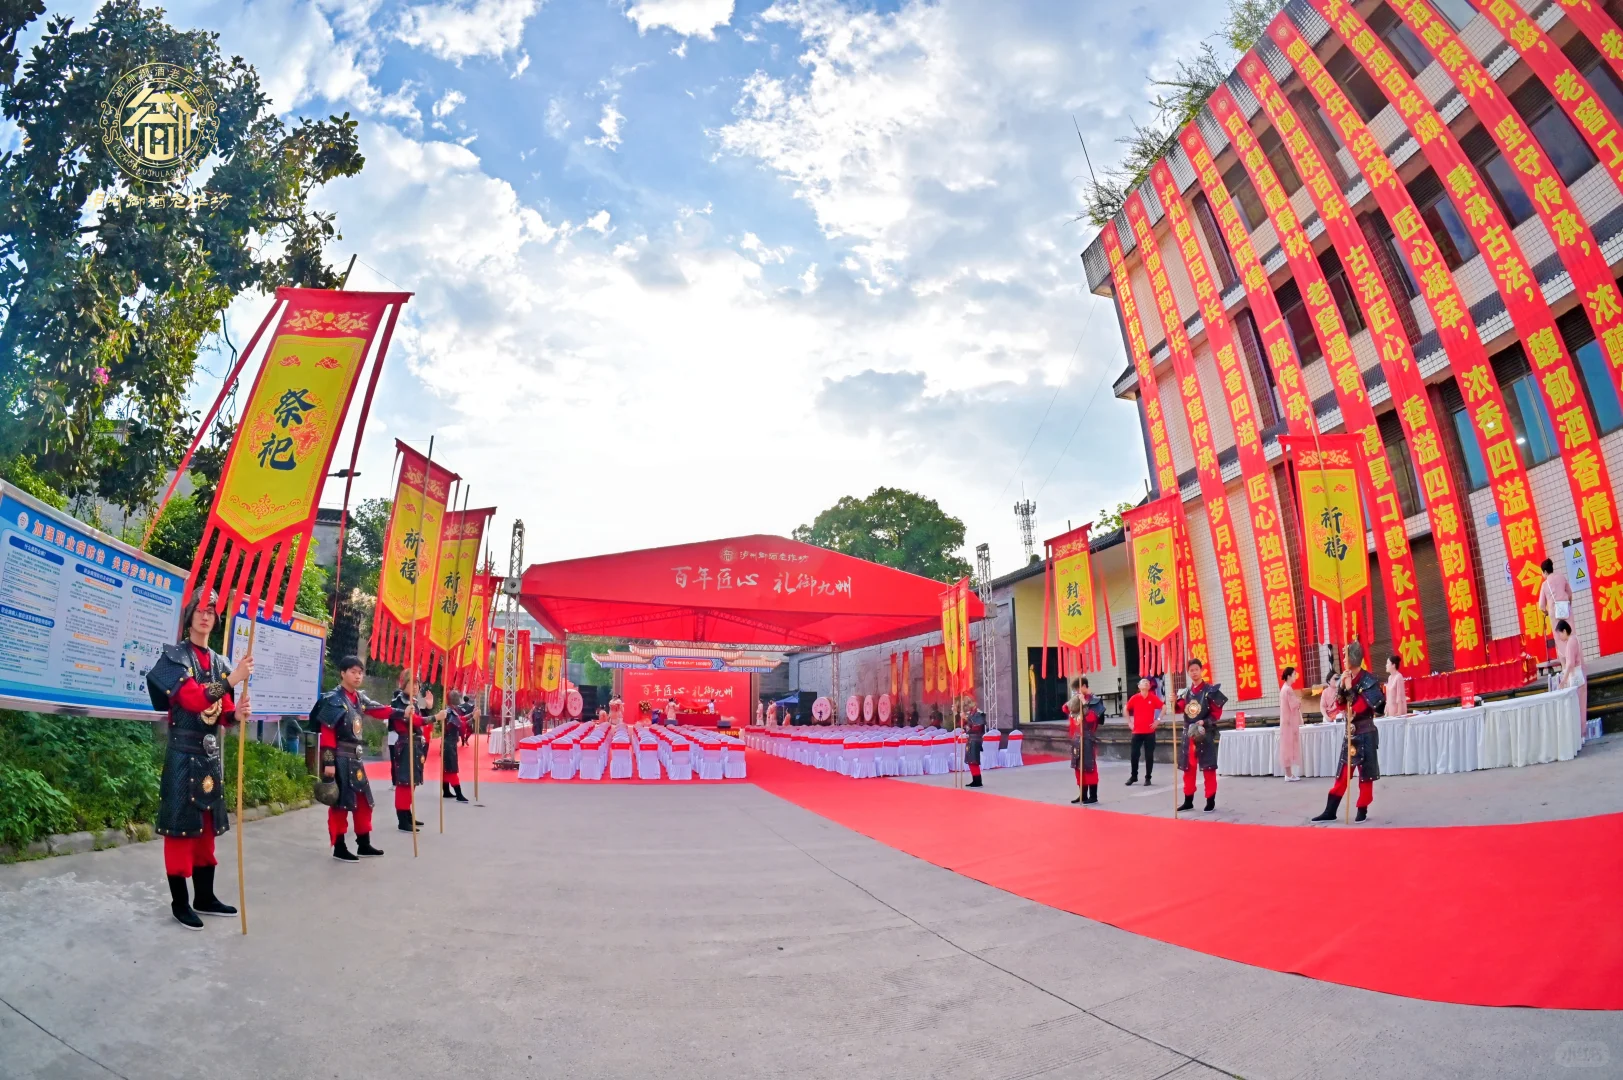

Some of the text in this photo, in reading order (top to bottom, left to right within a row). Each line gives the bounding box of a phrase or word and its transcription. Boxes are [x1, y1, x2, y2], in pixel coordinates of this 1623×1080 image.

[257, 388, 316, 471] 祭祀
[32, 519, 106, 565] 加强职业病防治
[111, 555, 172, 590] 关爱劳动者健康
[1320, 506, 1348, 561] 祈福
[400, 528, 424, 585] 祈福
[739, 550, 809, 564] 泸州御酒老作坊
[441, 571, 461, 616] 祈福
[671, 565, 852, 599] 百年匠心 礼御九州
[1066, 581, 1082, 617] 封坛
[1147, 562, 1165, 606] 祭祀
